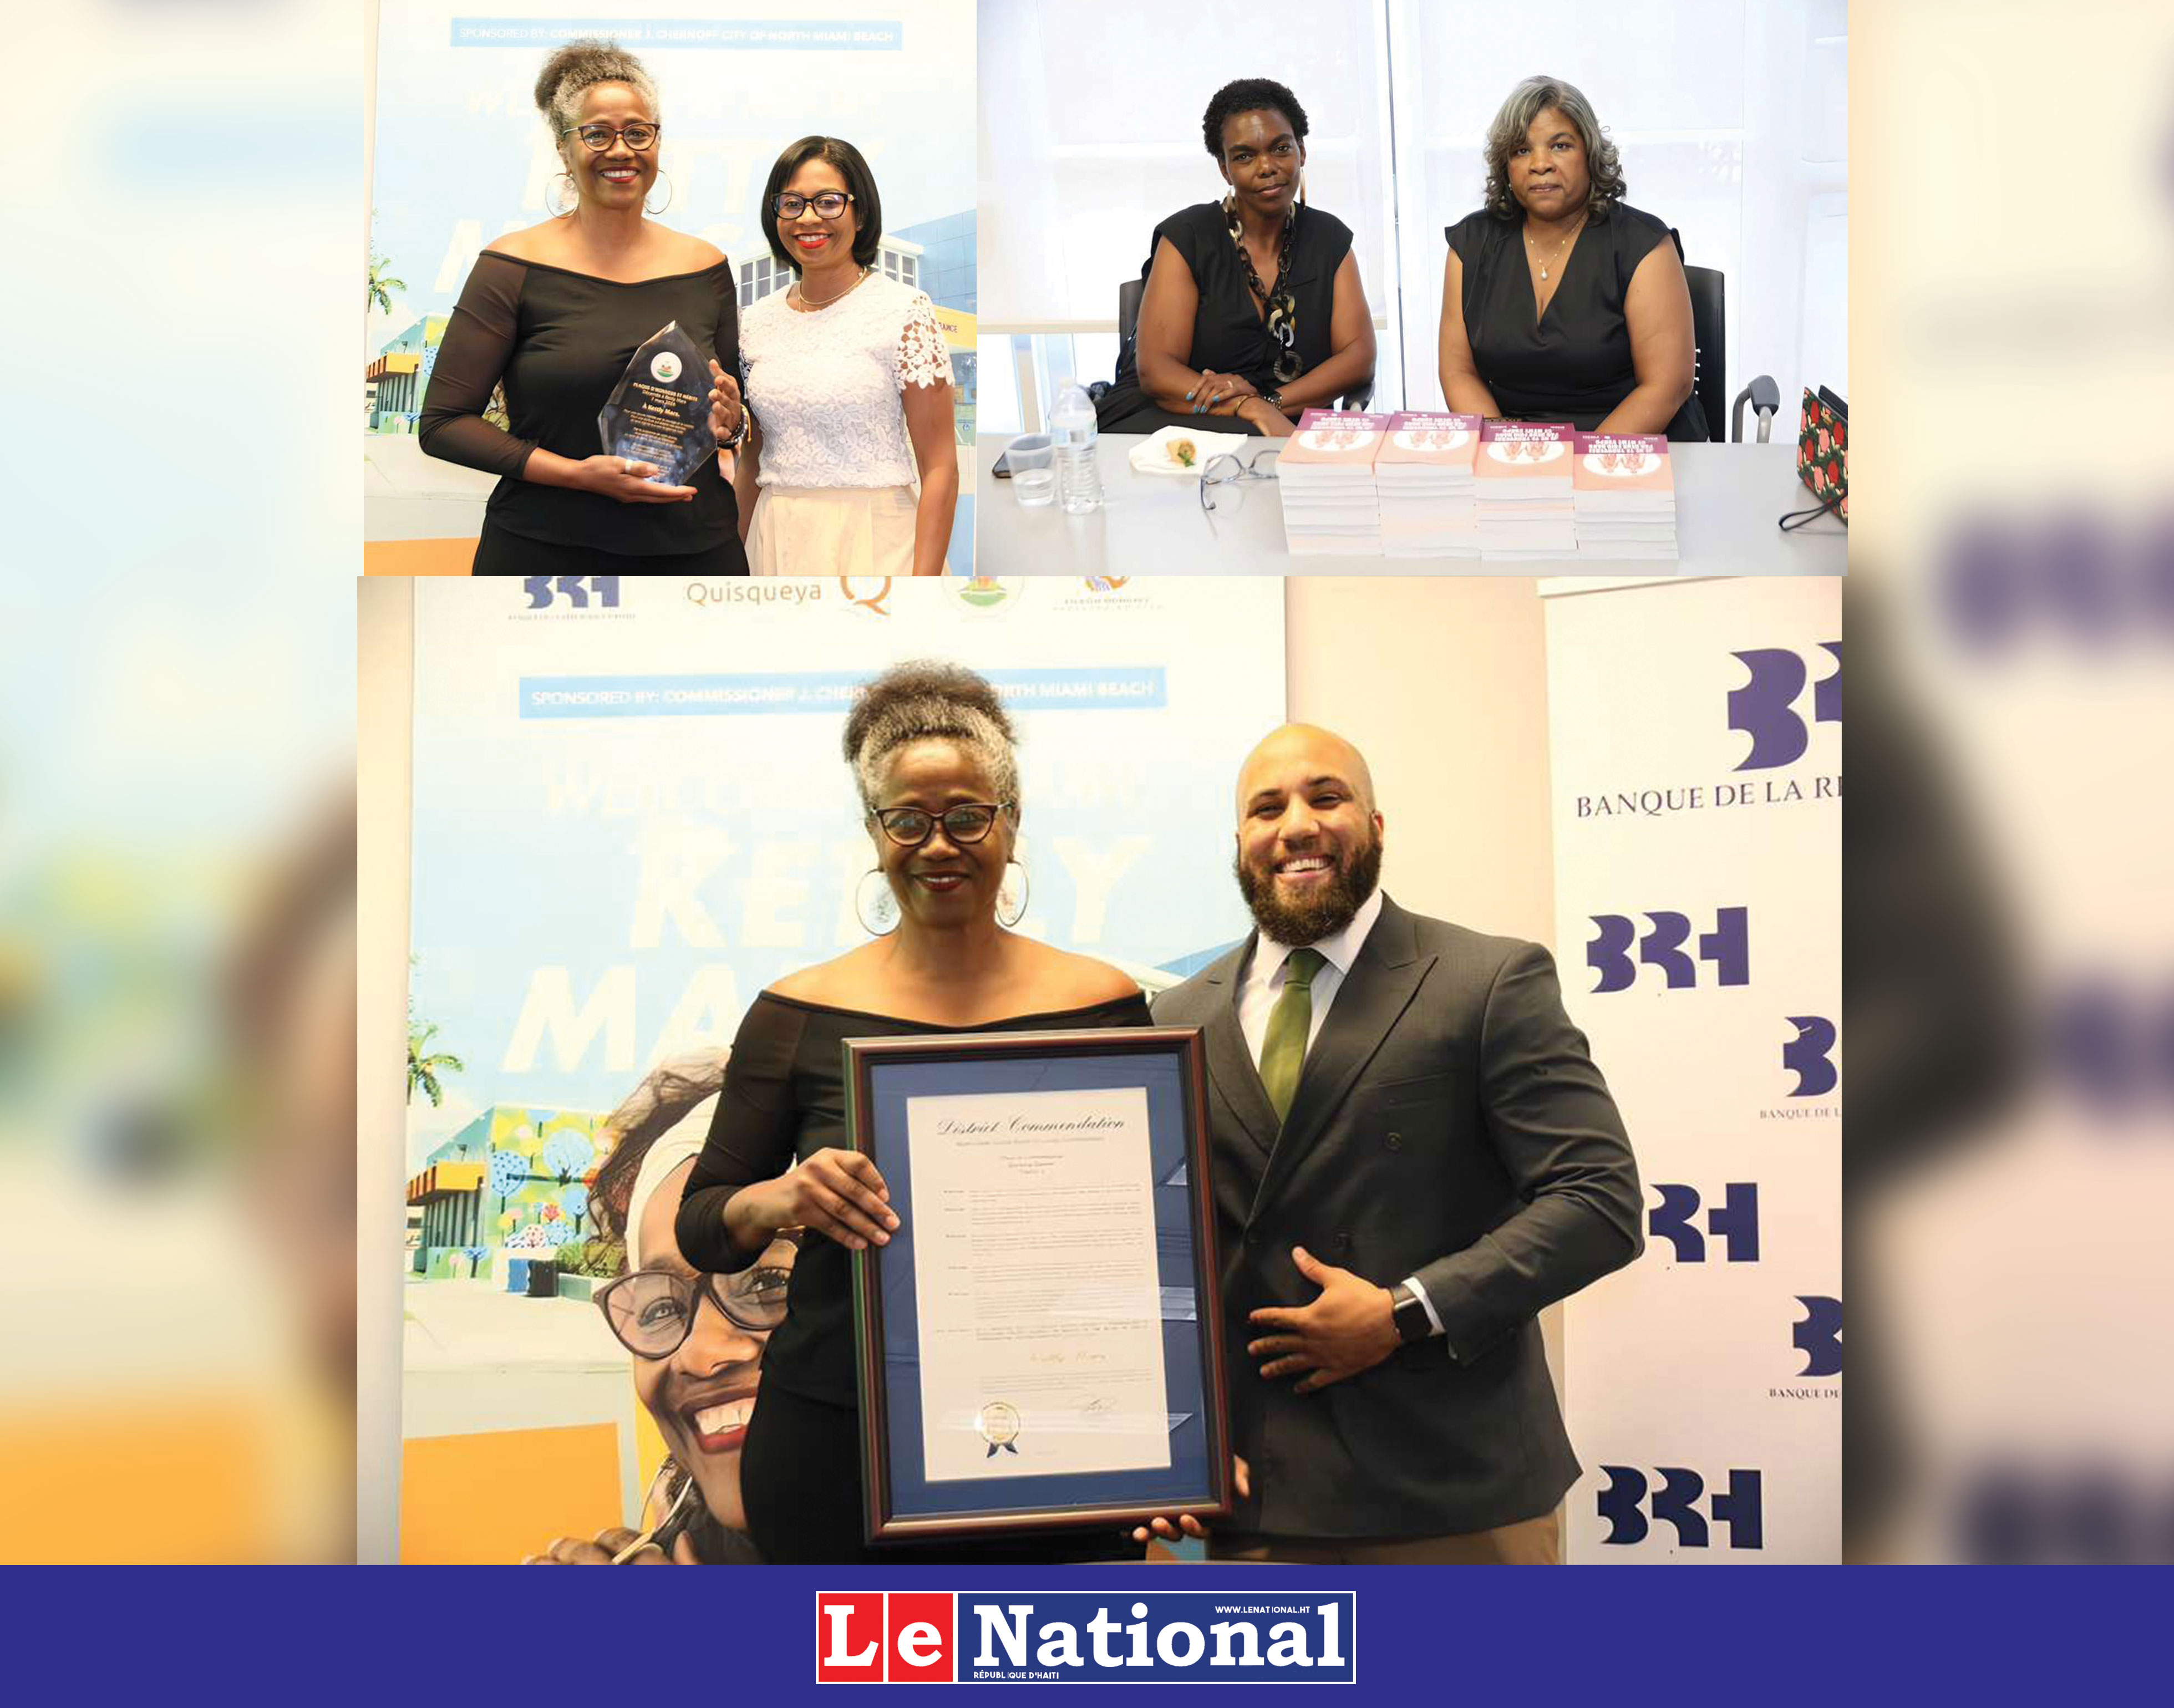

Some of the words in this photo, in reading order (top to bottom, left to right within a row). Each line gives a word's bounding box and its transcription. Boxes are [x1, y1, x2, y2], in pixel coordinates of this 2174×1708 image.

[459, 28, 528, 39] SPONSORED
[550, 28, 642, 39] COMMISSIONER
[854, 31, 894, 42] BEACH
[688, 582, 822, 607] Quisqueya
[531, 691, 631, 706] SPONSORED
[1039, 682, 1091, 698] MIAMI
[1097, 682, 1155, 697] BEACH
[1577, 786, 1705, 817] BANQUE
[1715, 782, 1755, 807] DE
[1766, 780, 1804, 802] LA
[1586, 907, 1750, 993] BRH
[1007, 1112, 1126, 1135] Commendation
[1760, 1109, 1810, 1120] BANQUE
[1769, 1389, 1819, 1400] BANQUE
[1597, 1465, 1762, 1549] BRH
